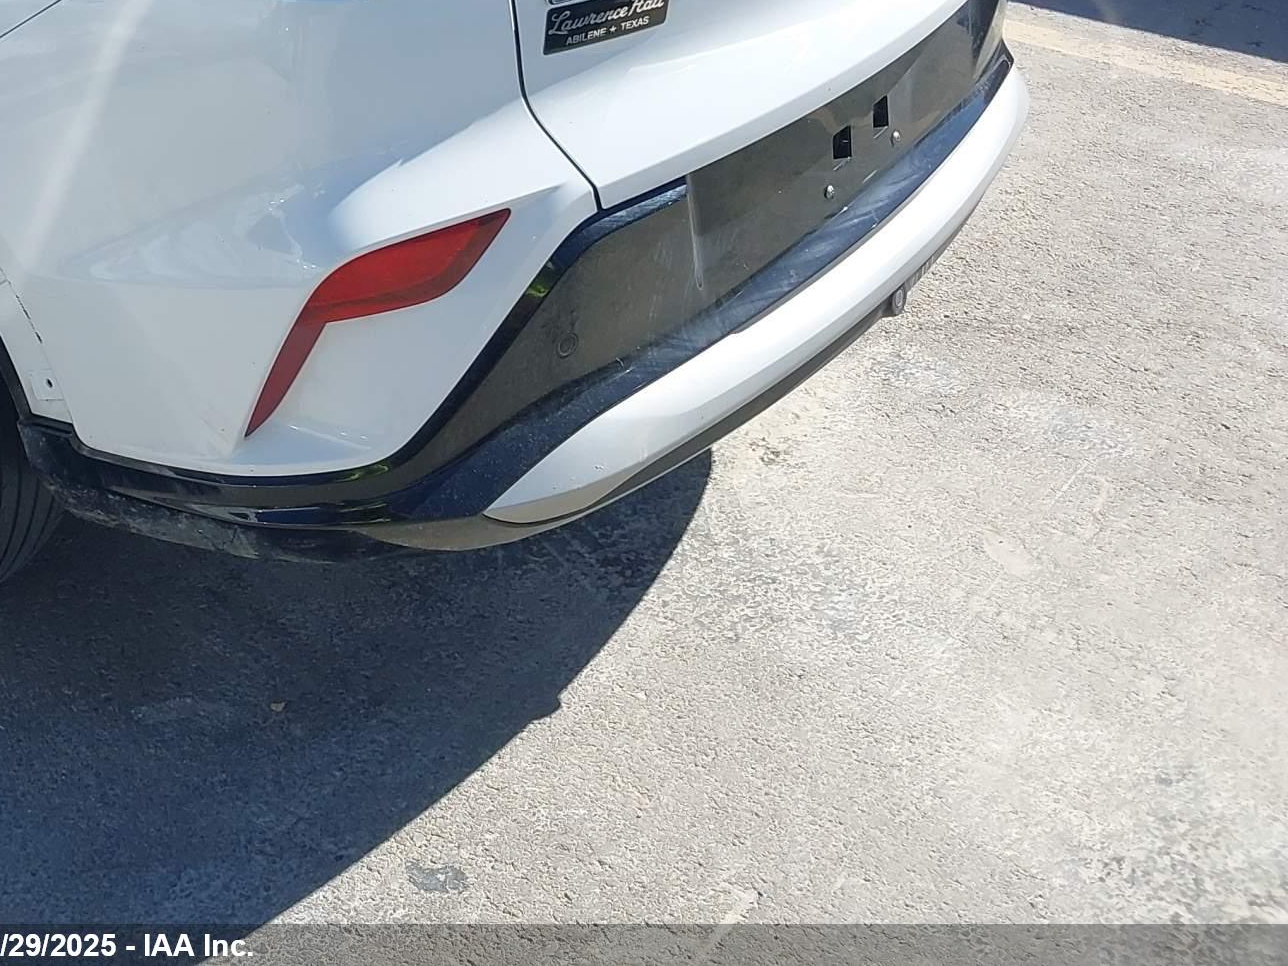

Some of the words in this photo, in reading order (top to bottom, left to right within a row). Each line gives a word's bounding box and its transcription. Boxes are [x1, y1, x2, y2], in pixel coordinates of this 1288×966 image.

[549, 10, 629, 35] Lawrence
[566, 28, 607, 46] ABILENE
[621, 16, 650, 31] TEXAS
